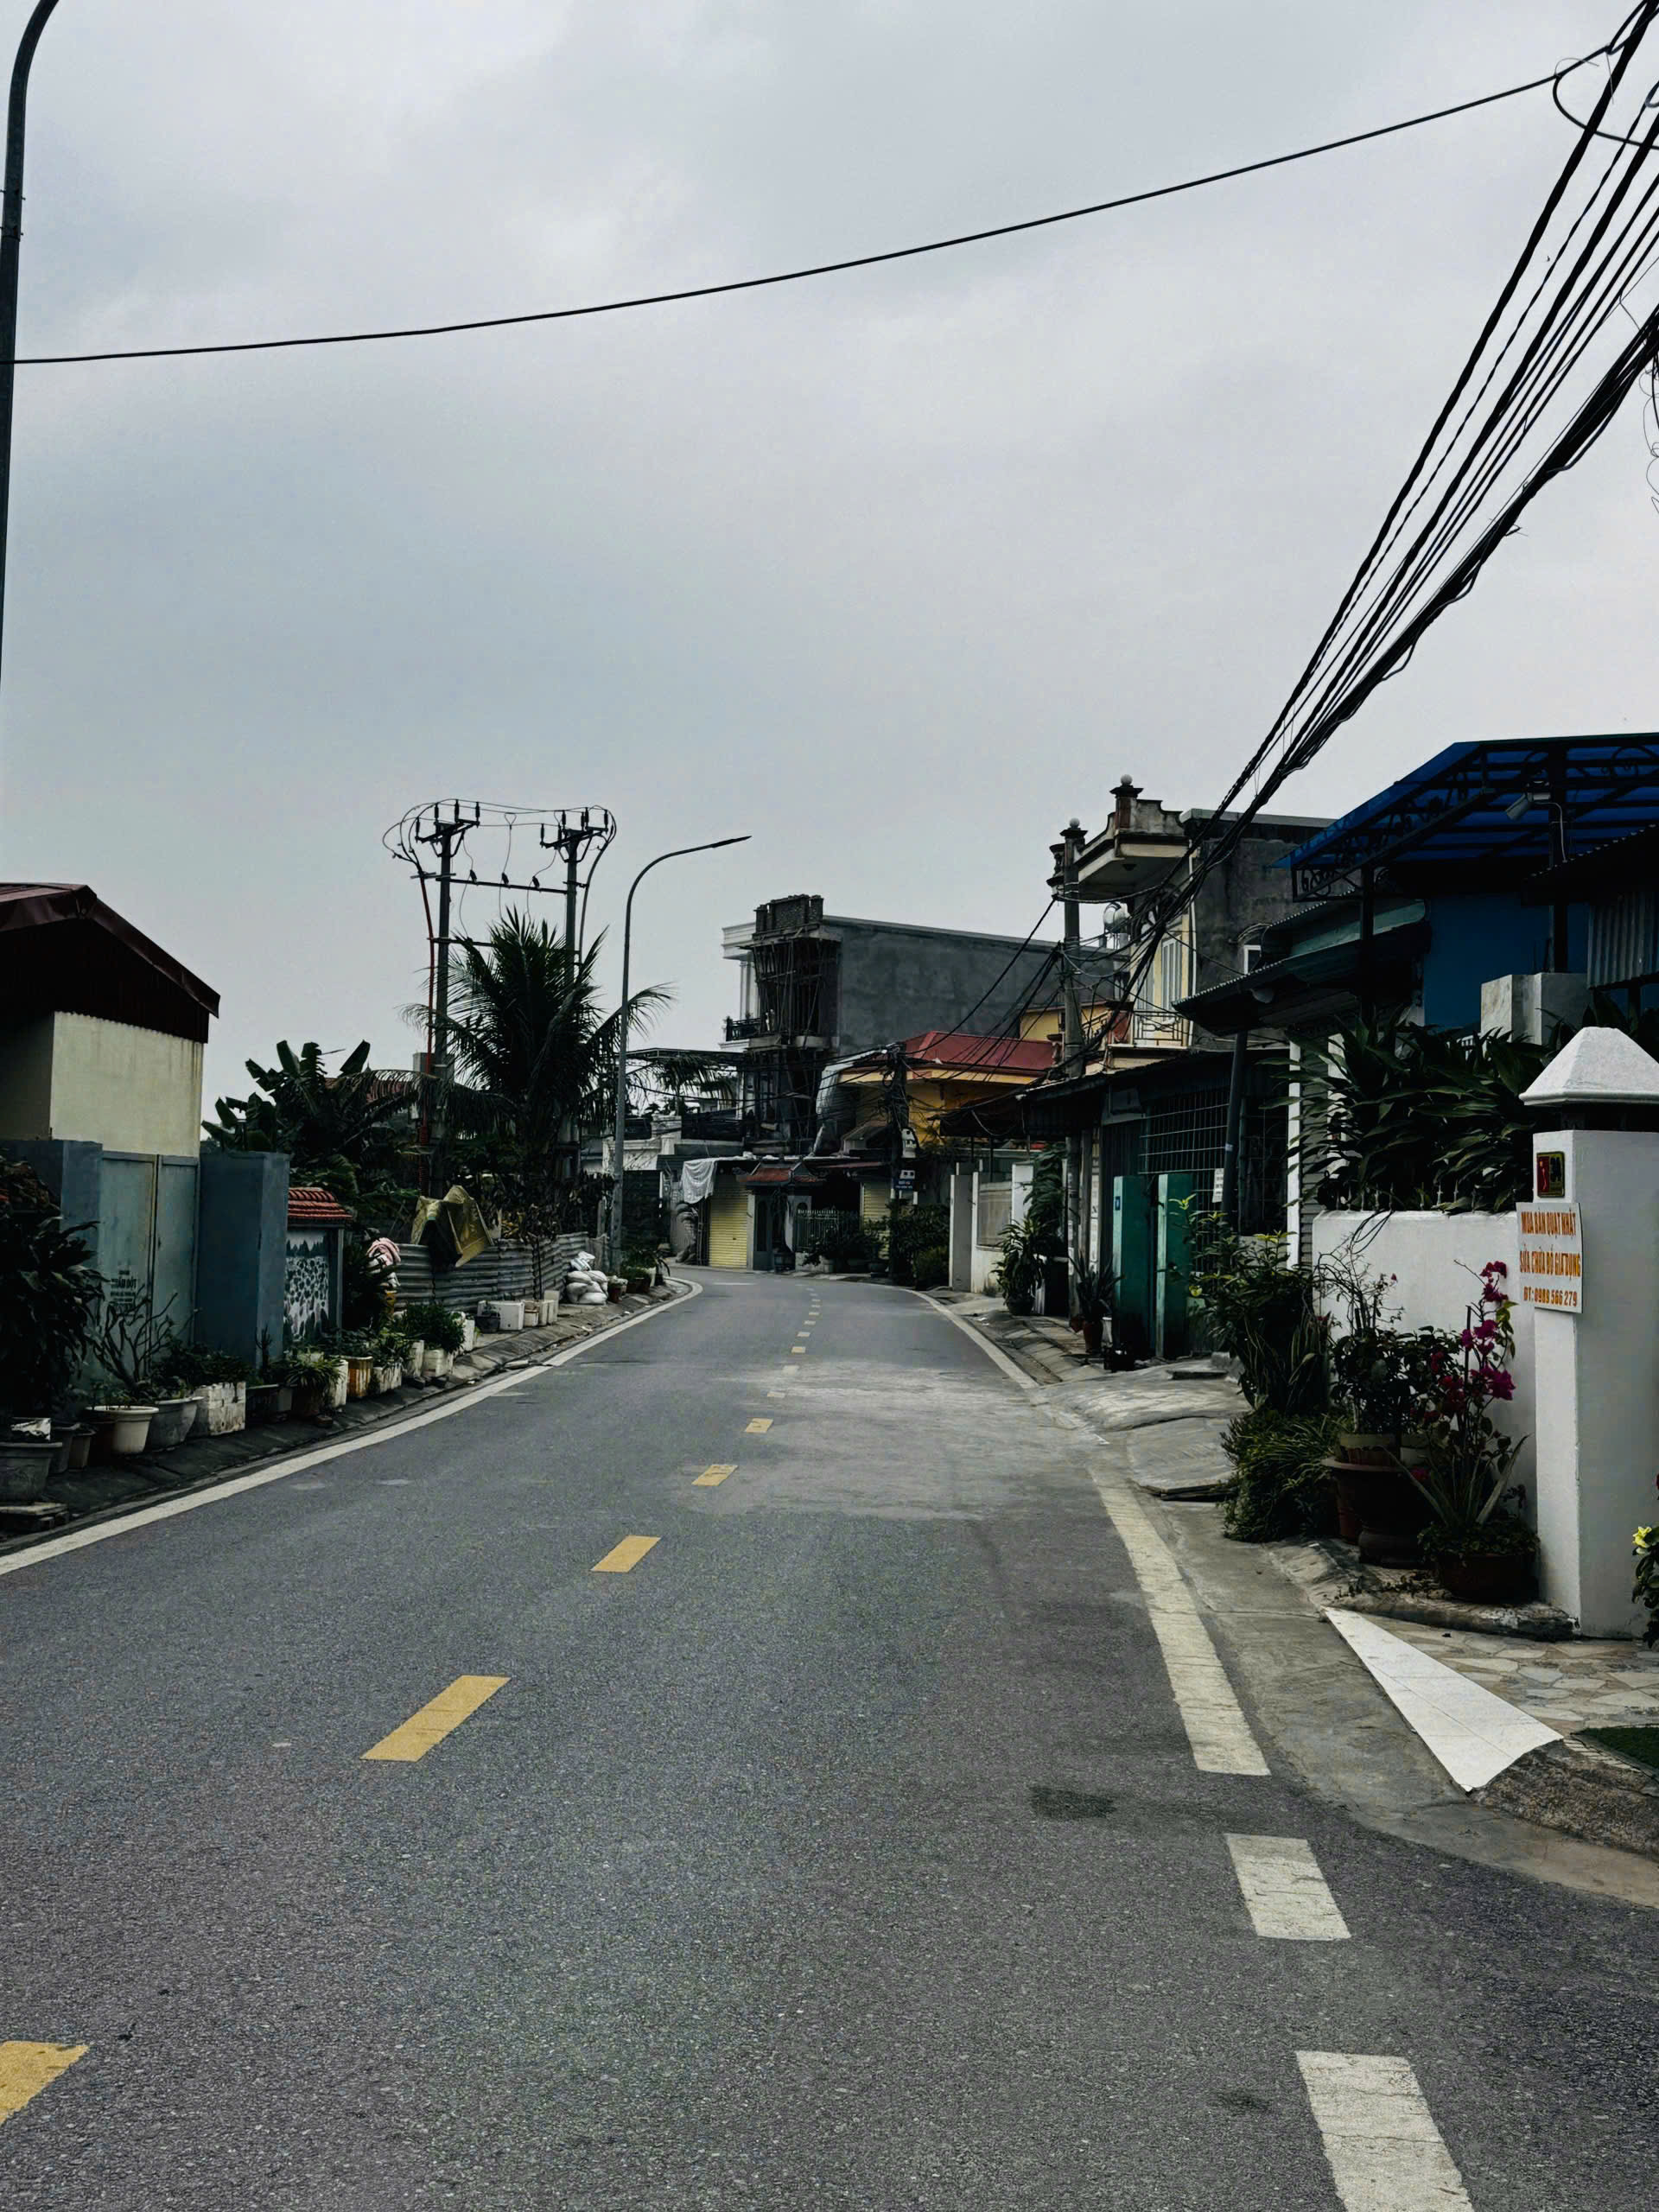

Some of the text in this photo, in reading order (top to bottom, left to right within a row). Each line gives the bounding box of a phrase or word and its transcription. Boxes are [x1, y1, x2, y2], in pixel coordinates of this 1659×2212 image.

[1521, 1211, 1534, 1234] MUA
[1547, 1211, 1560, 1239] QUẠT
[1551, 1289, 1563, 1306] 566
[1564, 1290, 1577, 1307] 279
